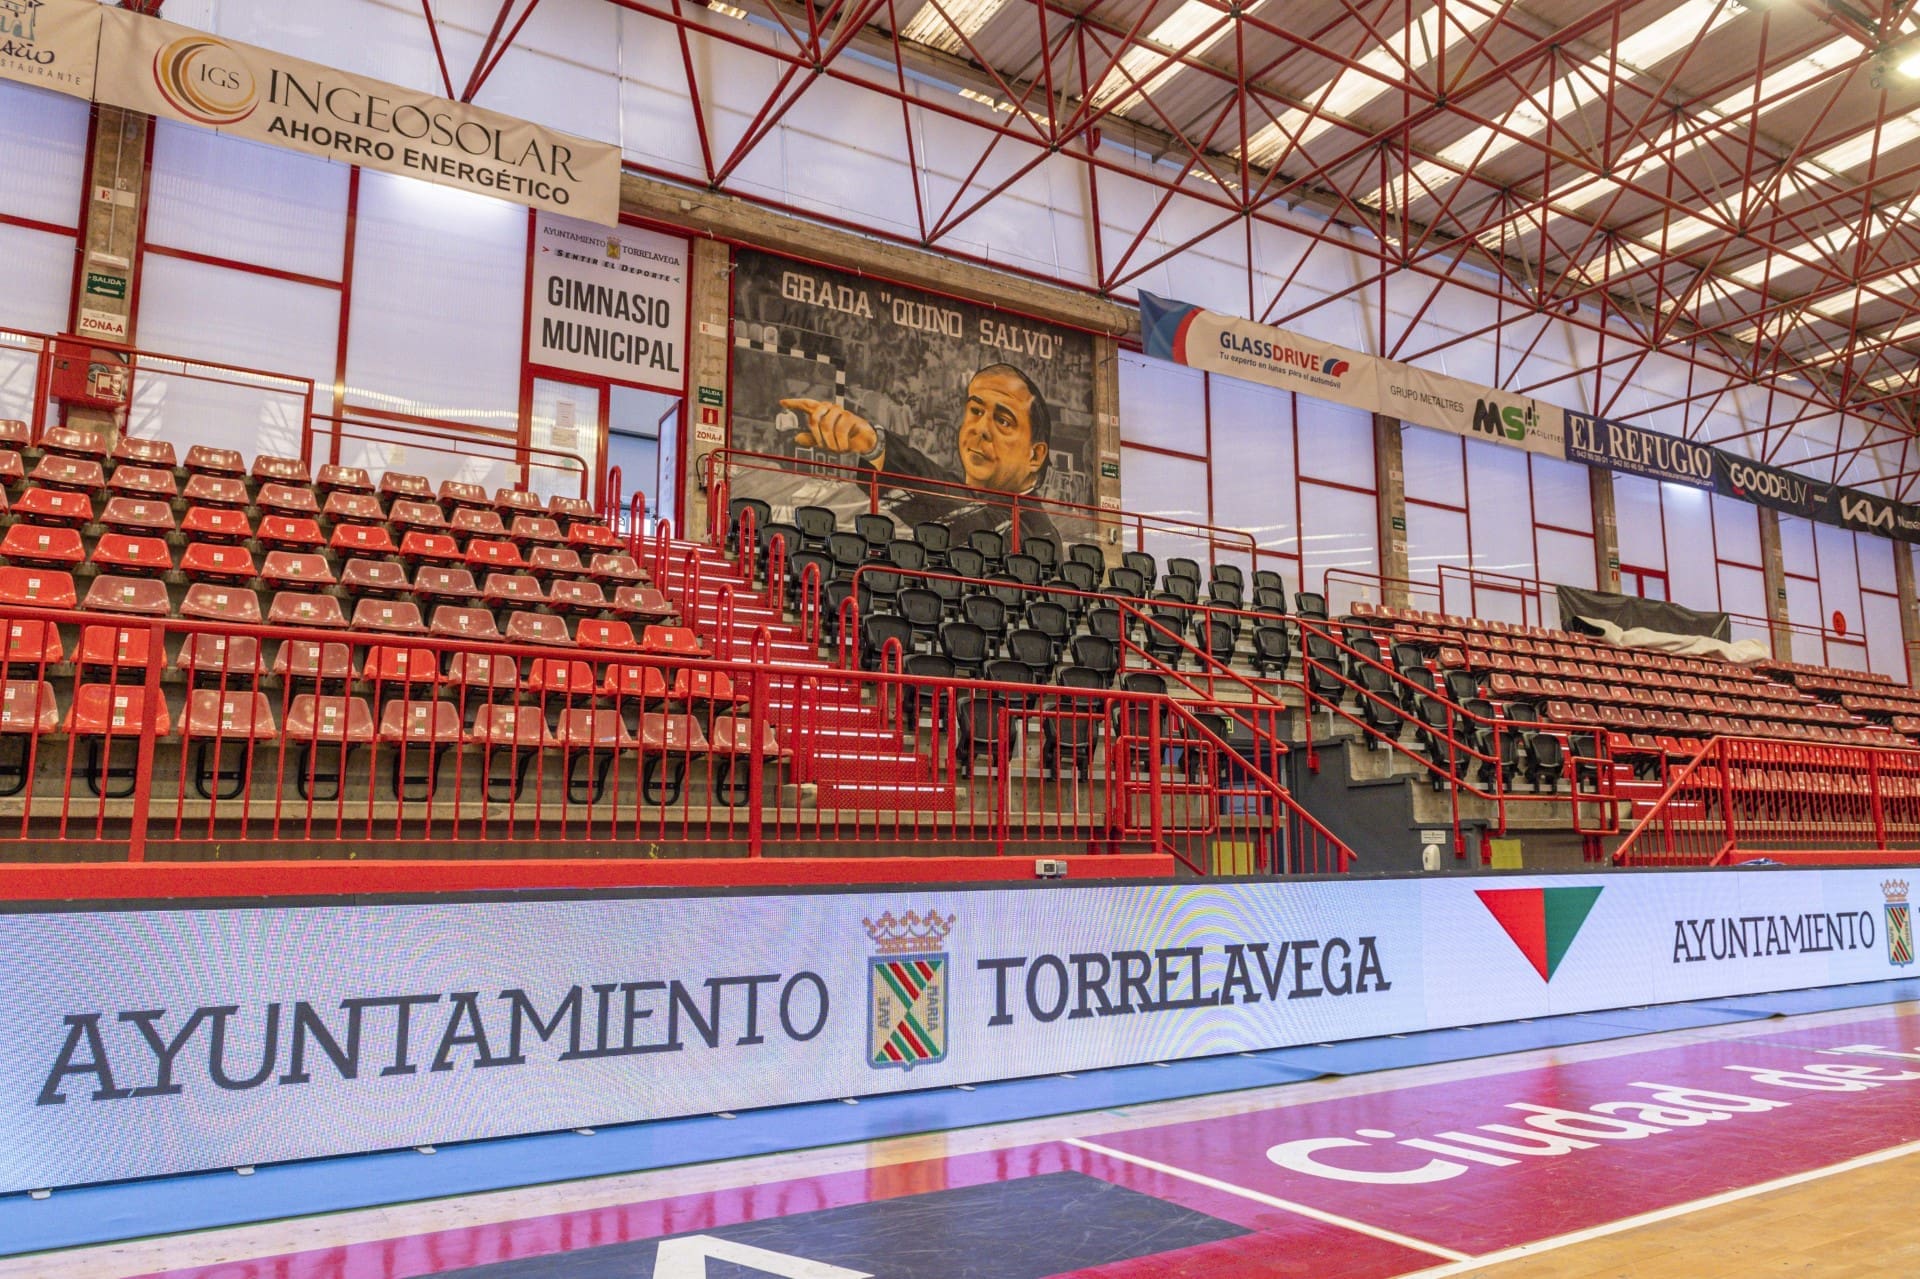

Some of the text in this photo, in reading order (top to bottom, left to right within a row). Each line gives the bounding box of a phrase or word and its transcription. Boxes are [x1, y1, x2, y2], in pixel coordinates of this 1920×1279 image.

[200, 63, 241, 90] IGS
[268, 69, 582, 182] INGEOSOLAR
[267, 116, 570, 205] AHORRO ENERGÉTICO
[543, 227, 680, 266] AYUNTAMIENTO TORRELAVEGA
[556, 249, 599, 265] SENTIR
[621, 264, 671, 282] DEPORTE
[92, 275, 122, 286] SALIDA
[548, 276, 670, 328] GIMNASIO
[781, 271, 1063, 360] GRADA "QUINO SALVO"
[82, 317, 123, 333] ZONA-A
[542, 317, 680, 373] MUNICIPAL
[1219, 352, 1229, 360] Tu
[1231, 355, 1257, 367] experto
[1268, 363, 1286, 374] lunas
[1310, 376, 1341, 389] automóvil
[1220, 331, 1320, 372] GLASSDRIVE
[701, 388, 721, 397] SALIDA
[1390, 385, 1464, 413] GRUPO METALTRES
[1472, 399, 1526, 441] MS
[1568, 414, 1604, 454] EL
[1606, 424, 1712, 479] REFUGIO
[1730, 463, 1807, 505] GOODBUY
[1673, 910, 1875, 964] AYUNTAMIENTO
[36, 936, 1392, 1106] AYUNTAMIENTO TORRELAVEGA
[878, 996, 890, 1029] AVE
[927, 985, 939, 1032] MARIA
[1266, 1064, 1920, 1185] Ciudad de
